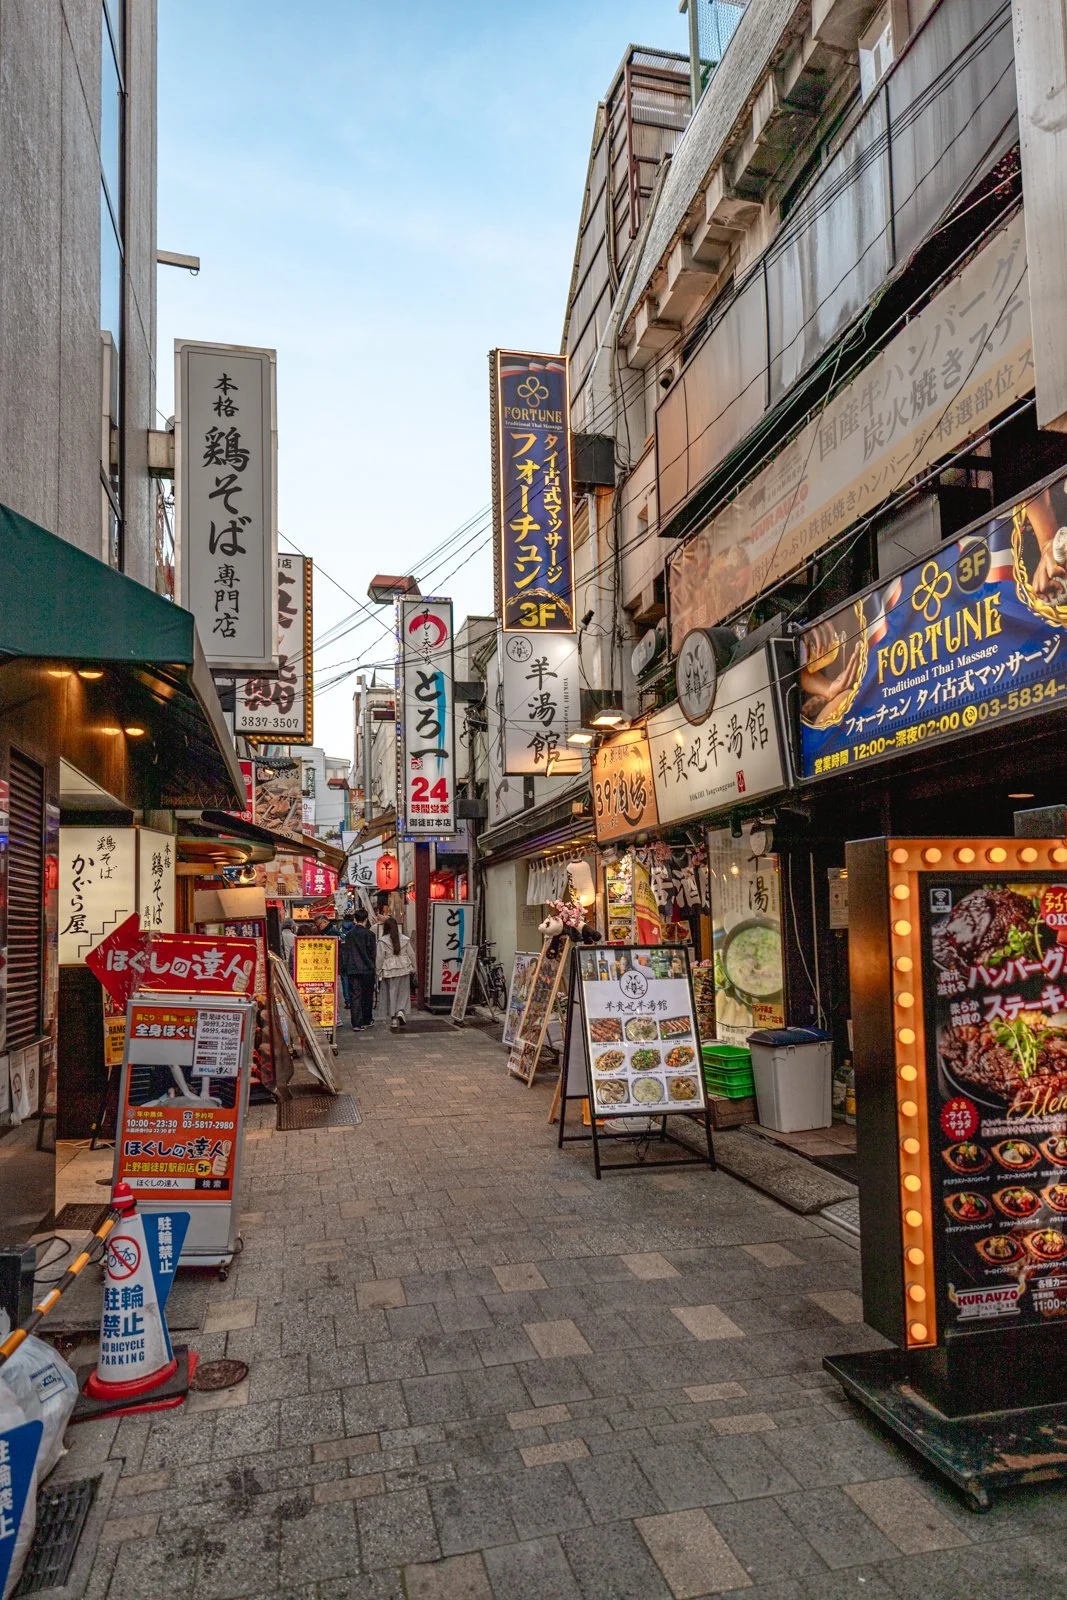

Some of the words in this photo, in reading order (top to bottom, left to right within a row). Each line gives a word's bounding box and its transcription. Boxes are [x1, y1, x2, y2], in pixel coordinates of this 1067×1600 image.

[504, 406, 562, 423] FORTUNE
[509, 432, 543, 589] フォーチュン
[543, 433, 563, 584] タイ古式マッサージ
[959, 549, 986, 583] 3F
[519, 602, 556, 627] 3F
[877, 592, 1003, 684] FORTUNE
[882, 669, 930, 698] Traditional
[931, 660, 955, 678] Thai
[957, 643, 999, 667] Massage
[845, 694, 913, 737] フォーチュン
[916, 635, 1061, 710] タイ古式マッサージ
[241, 717, 299, 728] 3837-3507
[525, 656, 561, 765] 羊湯館
[814, 749, 849, 774] 営業時間
[411, 777, 449, 802] 24
[411, 804, 449, 813] 時間営業
[409, 818, 451, 827] 御徒町本店
[96, 835, 118, 880] 鶏そば
[164, 842, 171, 869] 本格
[60, 854, 94, 936] かぐら屋
[106, 947, 247, 981] ほぐしの達人
[950, 1000, 980, 1014] 柔らか
[135, 1023, 196, 1038] 全身ほぐし
[182, 1120, 234, 1130] 03-5817-2980
[124, 1137, 225, 1160] ほぐしの達人
[123, 1162, 195, 1173] 上野御徒町駅前店
[197, 1164, 211, 1173] 5F
[136, 1180, 179, 1188] ほぐしの達人
[202, 1180, 222, 1188] 検索
[157, 1216, 173, 1274] 駐輪禁止
[104, 1284, 144, 1311] 駐輪
[958, 1289, 1018, 1306] KURAUZO
[103, 1312, 145, 1338] 禁止
[102, 1342, 110, 1352] NO
[110, 1338, 145, 1353] BICYCLE
[101, 1351, 145, 1366] PARKING
